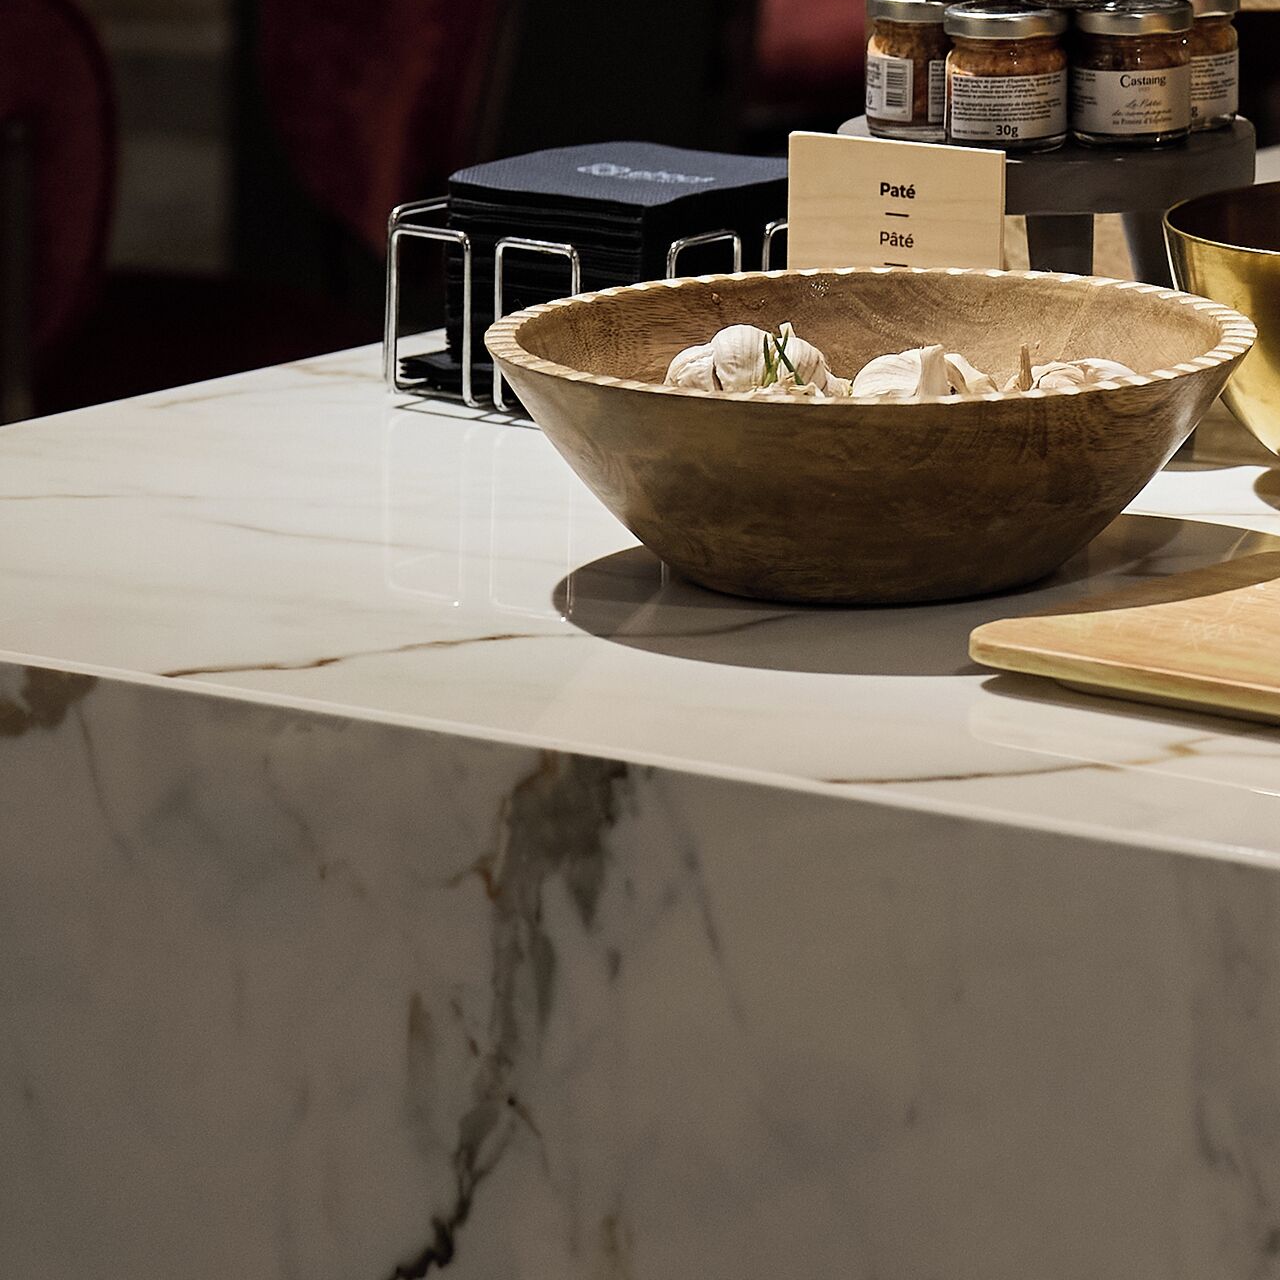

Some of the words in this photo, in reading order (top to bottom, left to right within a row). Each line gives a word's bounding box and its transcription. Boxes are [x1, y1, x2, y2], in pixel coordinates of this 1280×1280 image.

[1120, 74, 1166, 89] Castaing
[996, 124, 1018, 138] 30g
[880, 182, 916, 199] Paté
[880, 231, 914, 248] Pâté
